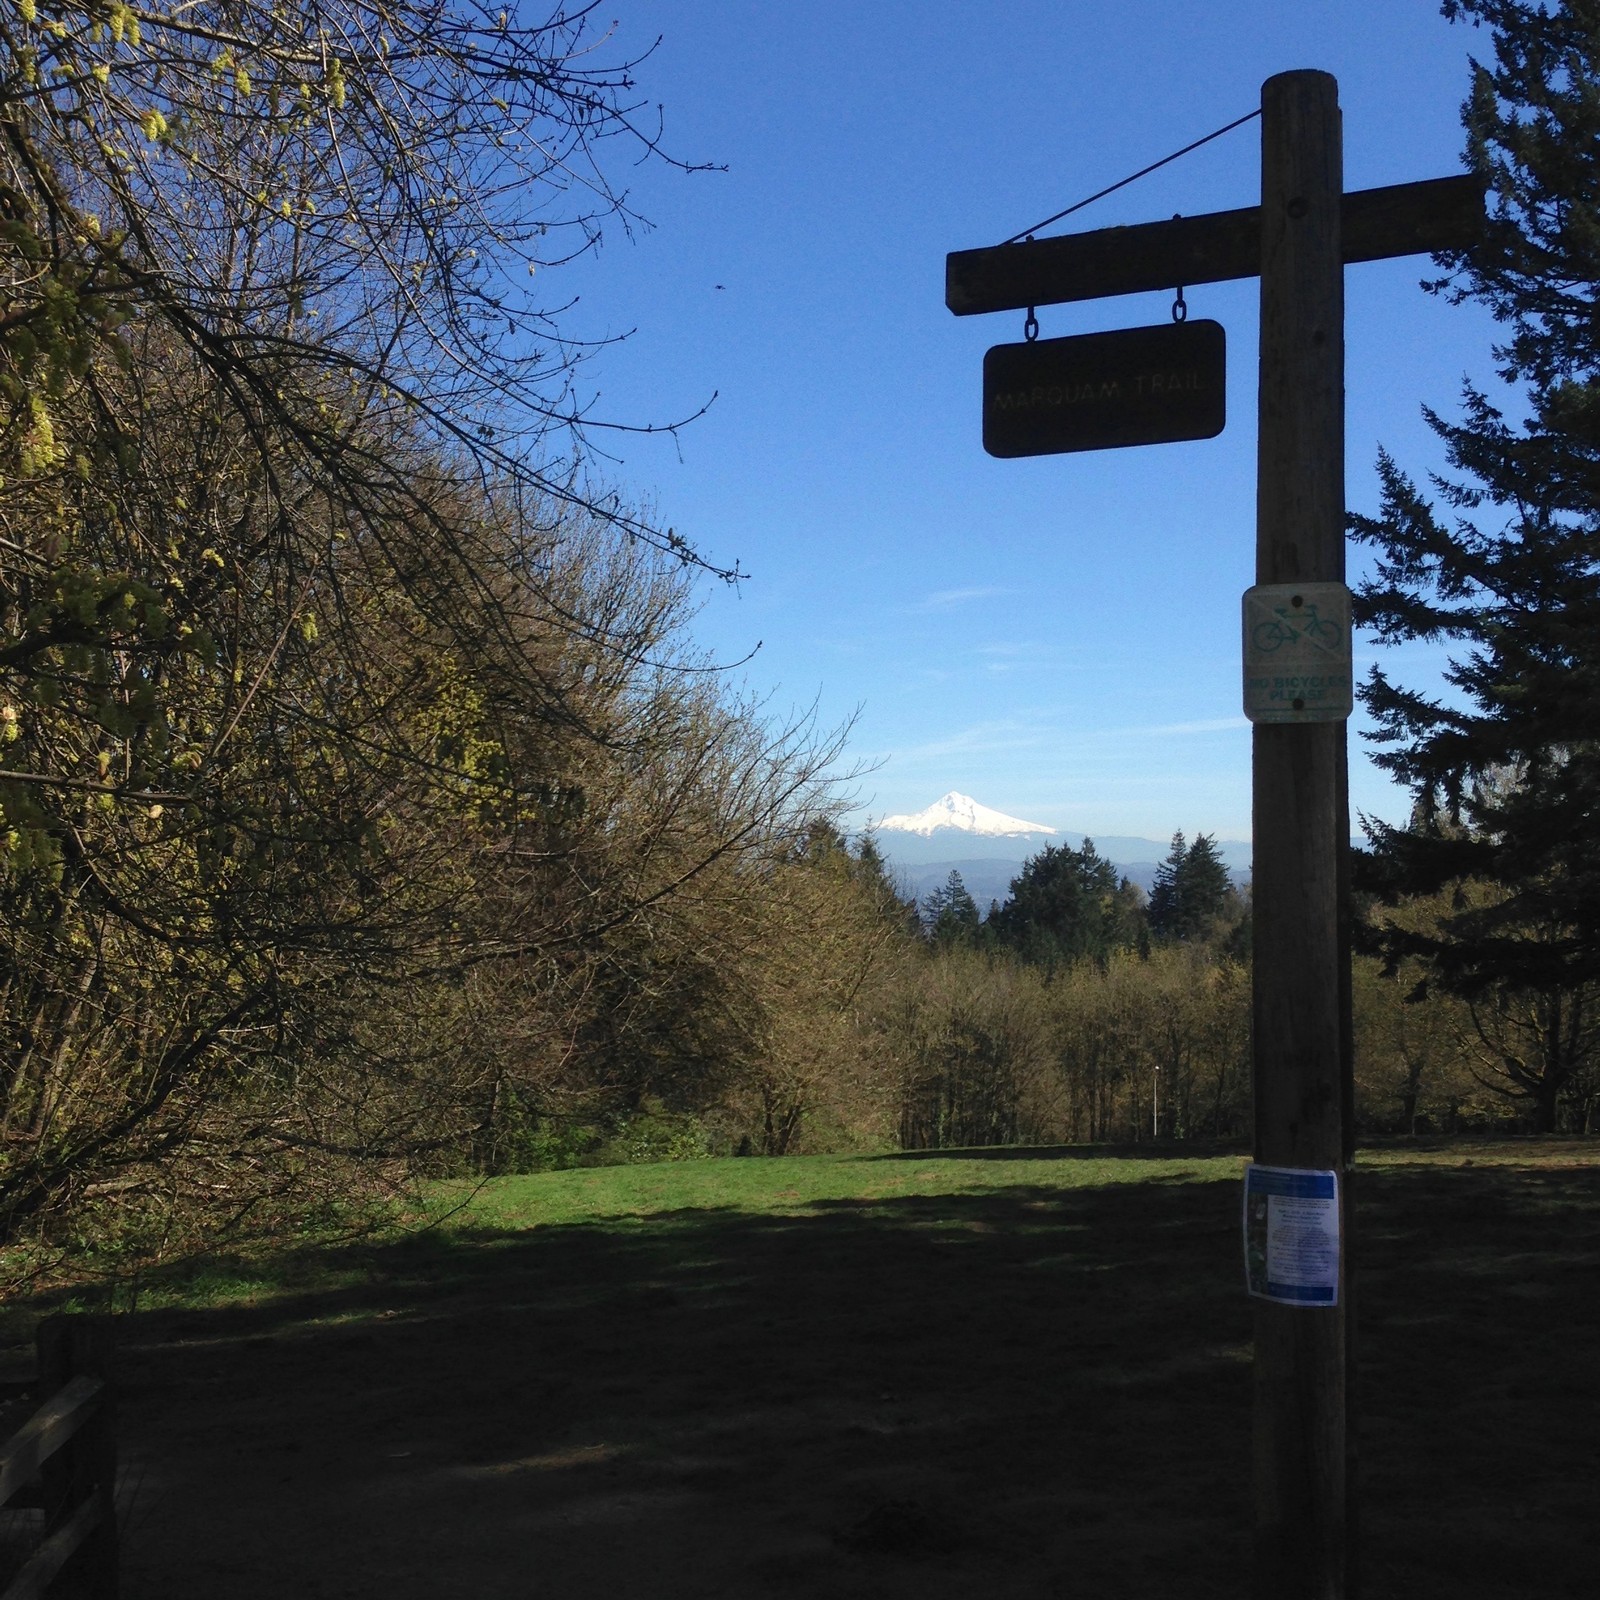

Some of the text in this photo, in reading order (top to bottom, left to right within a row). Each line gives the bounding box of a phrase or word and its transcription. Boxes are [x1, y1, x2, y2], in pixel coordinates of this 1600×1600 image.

[992, 373, 1208, 410] MARQUAM TRAIL
[1249, 675, 1347, 688] NO BICYCLES
[1269, 689, 1324, 700] PLEASE
